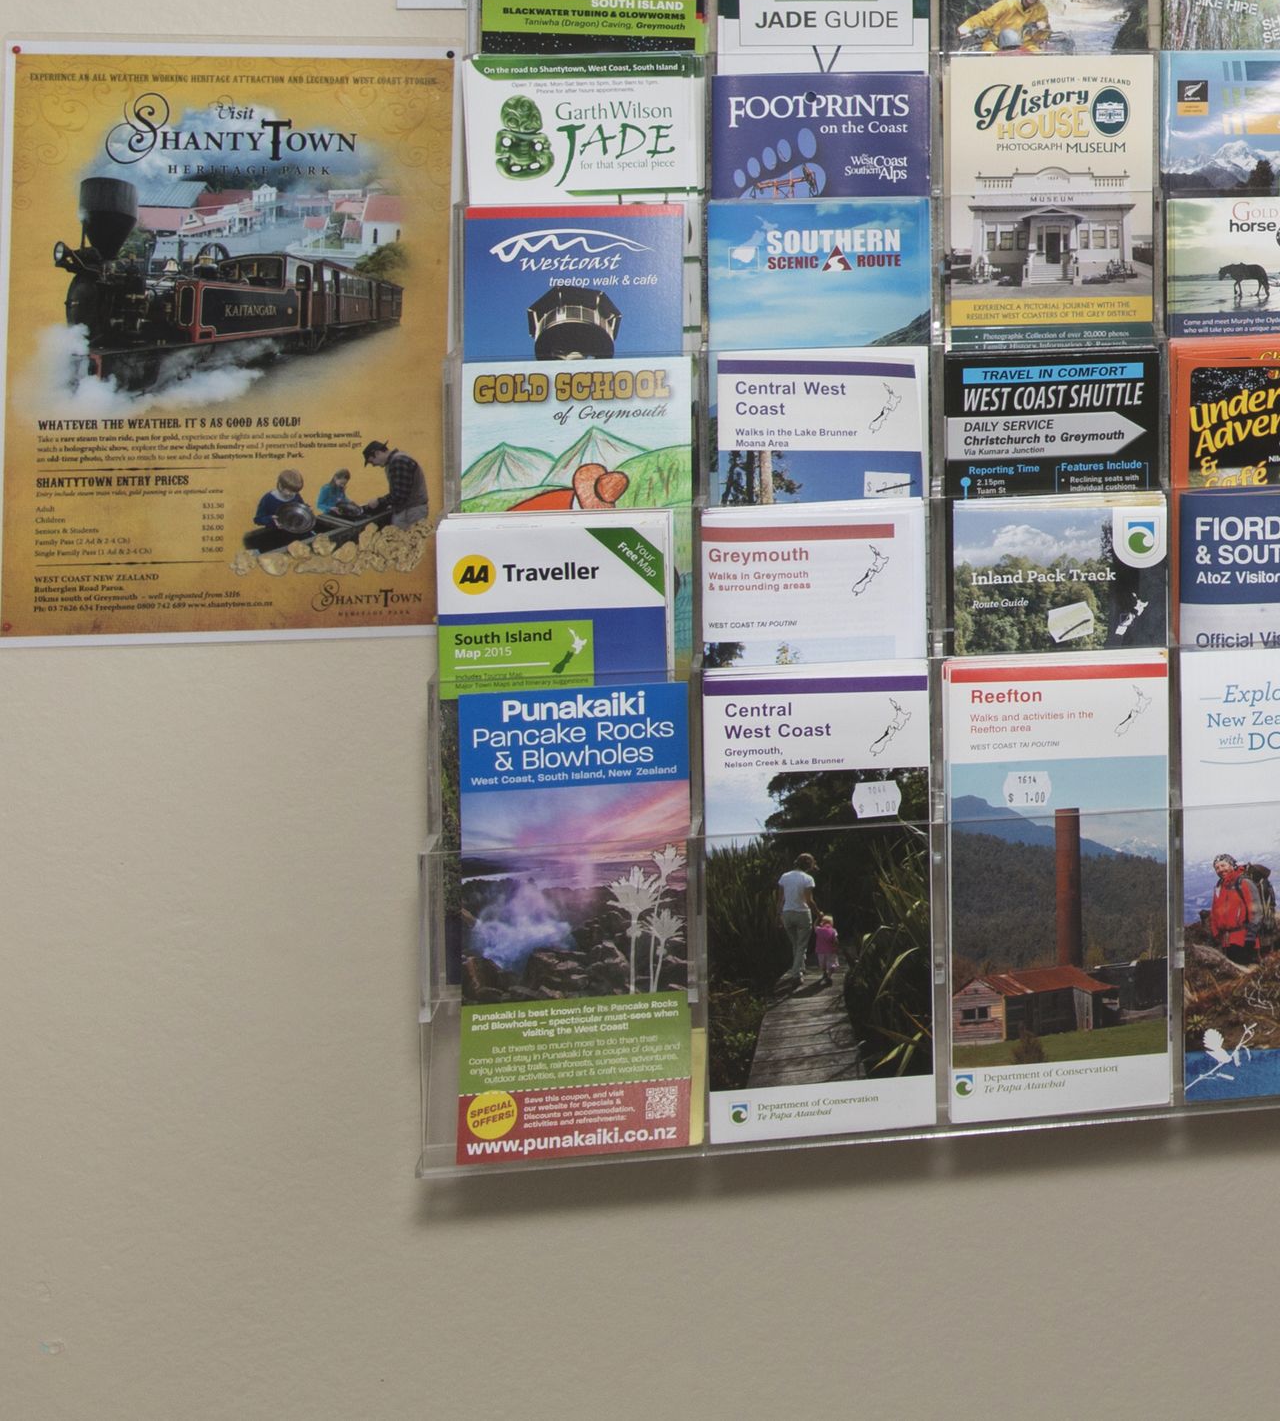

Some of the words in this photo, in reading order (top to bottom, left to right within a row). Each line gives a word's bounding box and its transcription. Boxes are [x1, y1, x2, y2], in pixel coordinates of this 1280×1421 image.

[756, 11, 817, 29] JADE
[825, 11, 899, 28] GUIDE
[729, 93, 909, 127] FOOTPRINTS
[168, 164, 271, 176] HERITAGE
[281, 165, 330, 176] PARK
[767, 229, 900, 253] SOUTHERN
[767, 255, 819, 269] SCENIC
[858, 255, 901, 268] ROUTE
[963, 385, 1008, 410] WEST
[1012, 383, 1065, 410] COAST
[1070, 382, 1143, 408] SHUTTLE
[708, 548, 809, 565] Greymouth
[503, 562, 599, 583] Traveller
[454, 632, 502, 646] South
[506, 630, 552, 644] Island
[502, 691, 645, 723] Punakaiki
[970, 689, 1042, 705] Reefton
[473, 721, 588, 747] Pancake
[597, 718, 674, 740] Rocks
[471, 777, 498, 785] West
[502, 775, 535, 784] Coast,
[538, 773, 568, 782] South
[572, 770, 605, 780] Island,
[608, 769, 631, 777] New
[636, 765, 677, 775] Zealand
[758, 1102, 808, 1111] Department
[823, 1096, 879, 1106] Conservation
[467, 1126, 677, 1155] www.punakaiki.co.nz
